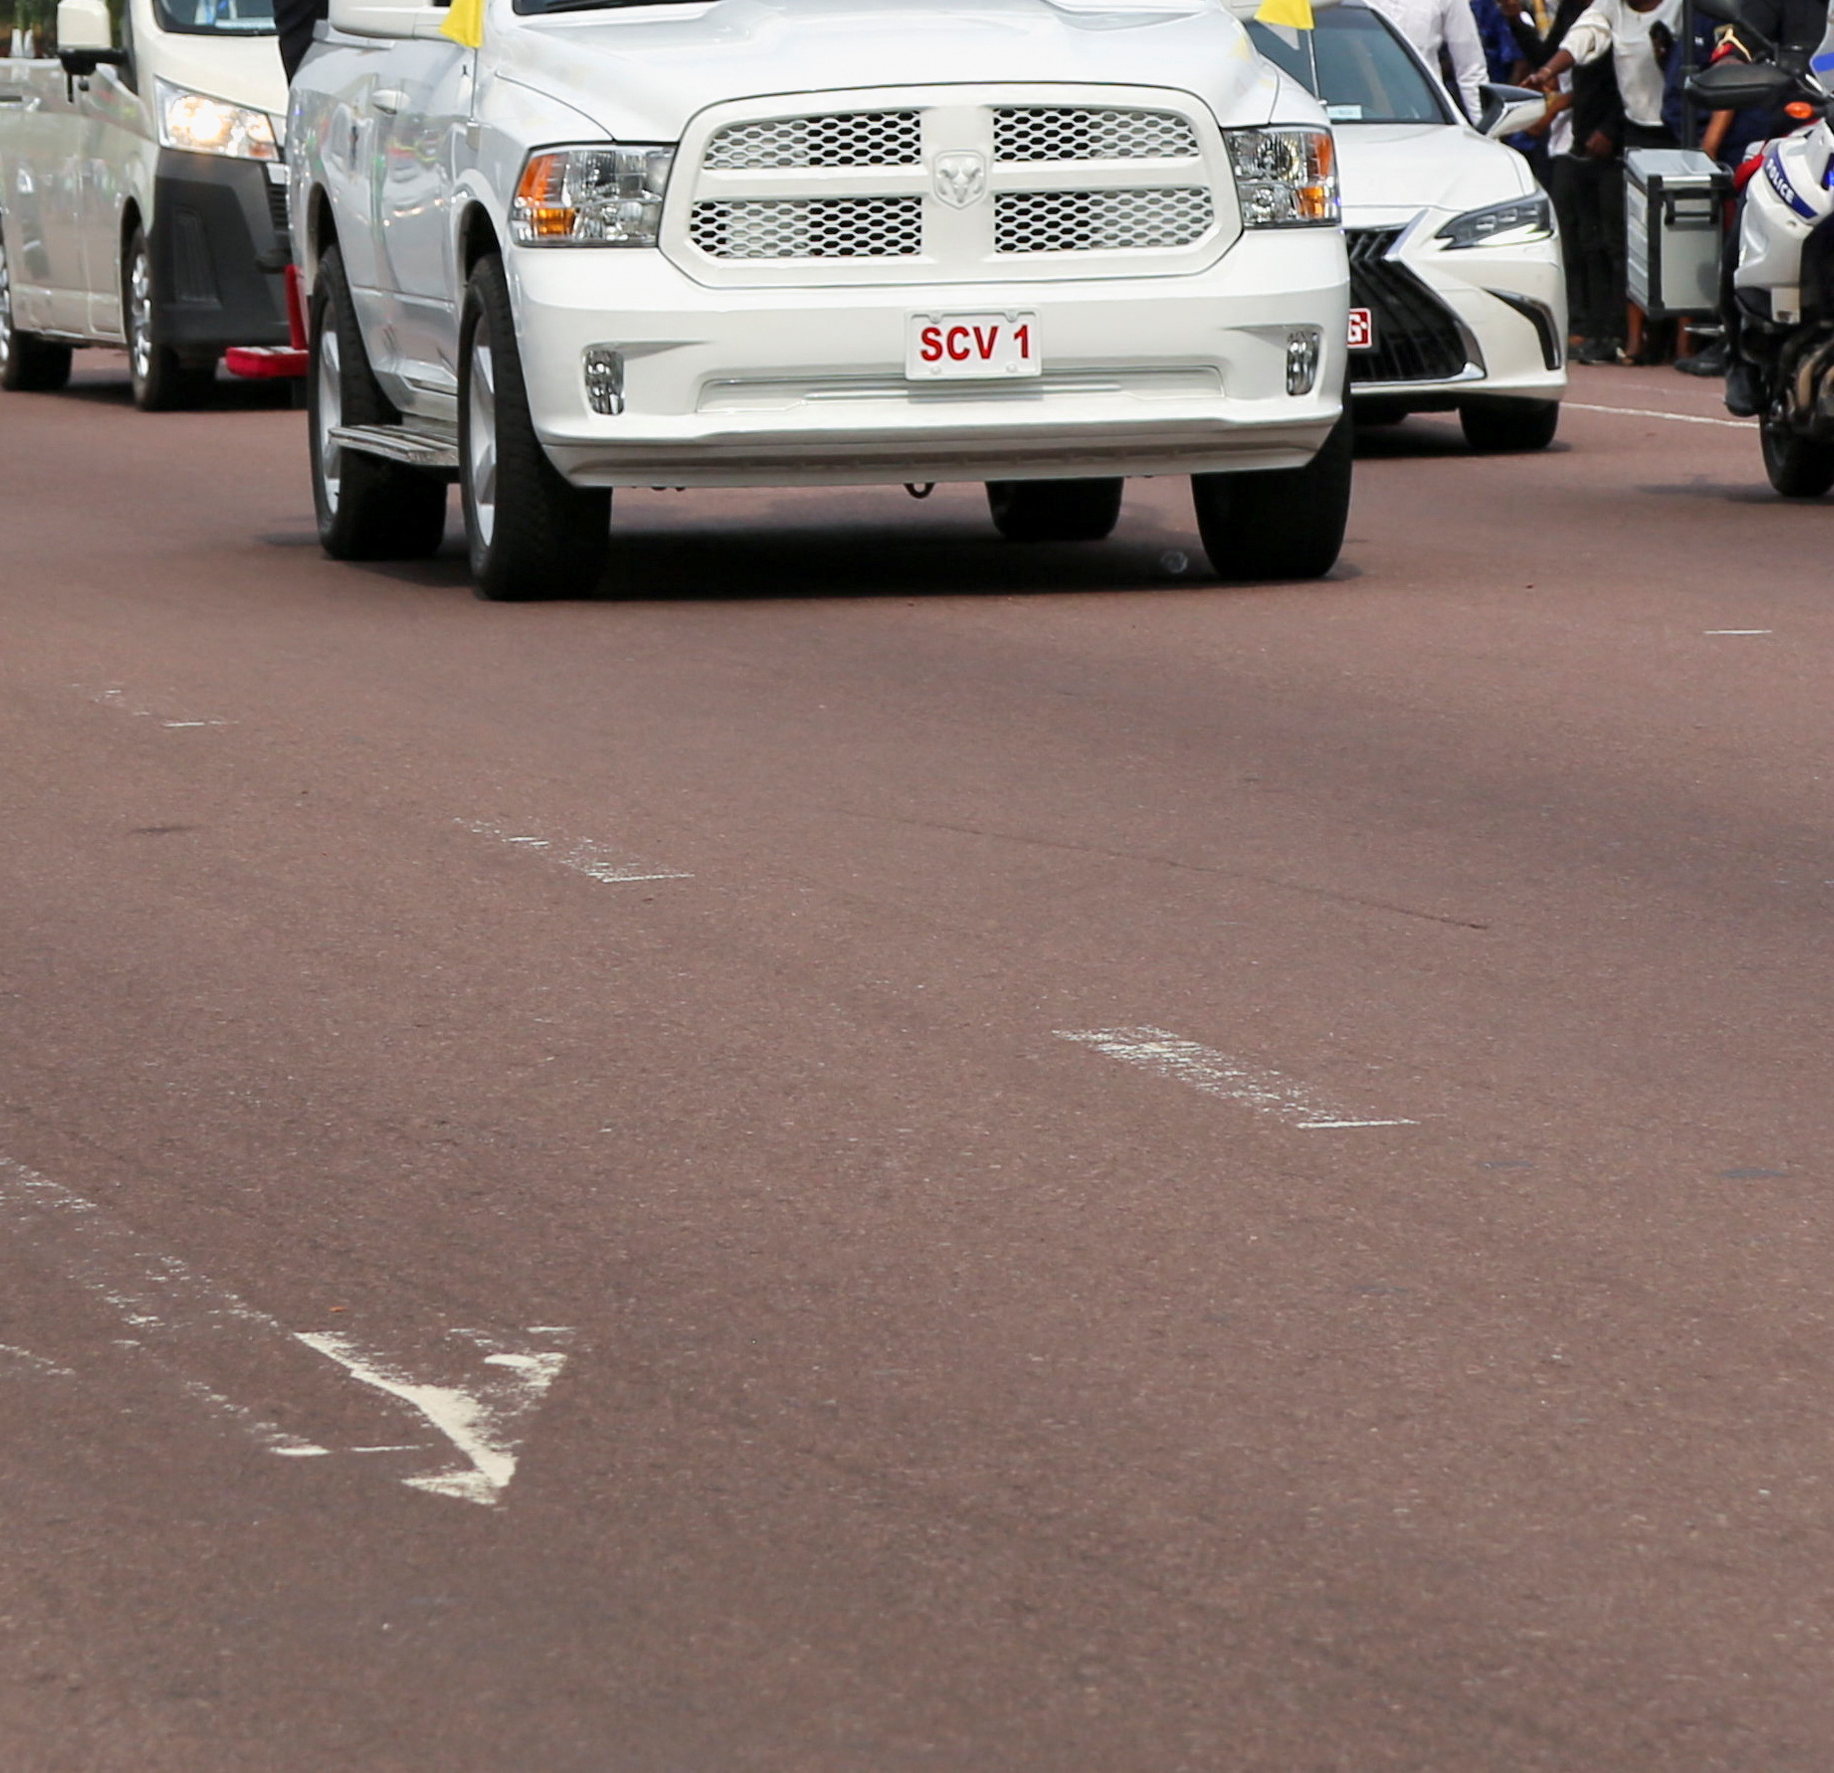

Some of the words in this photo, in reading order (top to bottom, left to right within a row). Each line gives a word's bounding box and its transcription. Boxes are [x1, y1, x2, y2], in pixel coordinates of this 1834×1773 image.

[1766, 156, 1796, 205] POLICE
[919, 325, 1000, 362] SCV
[1012, 323, 1030, 360] 1
